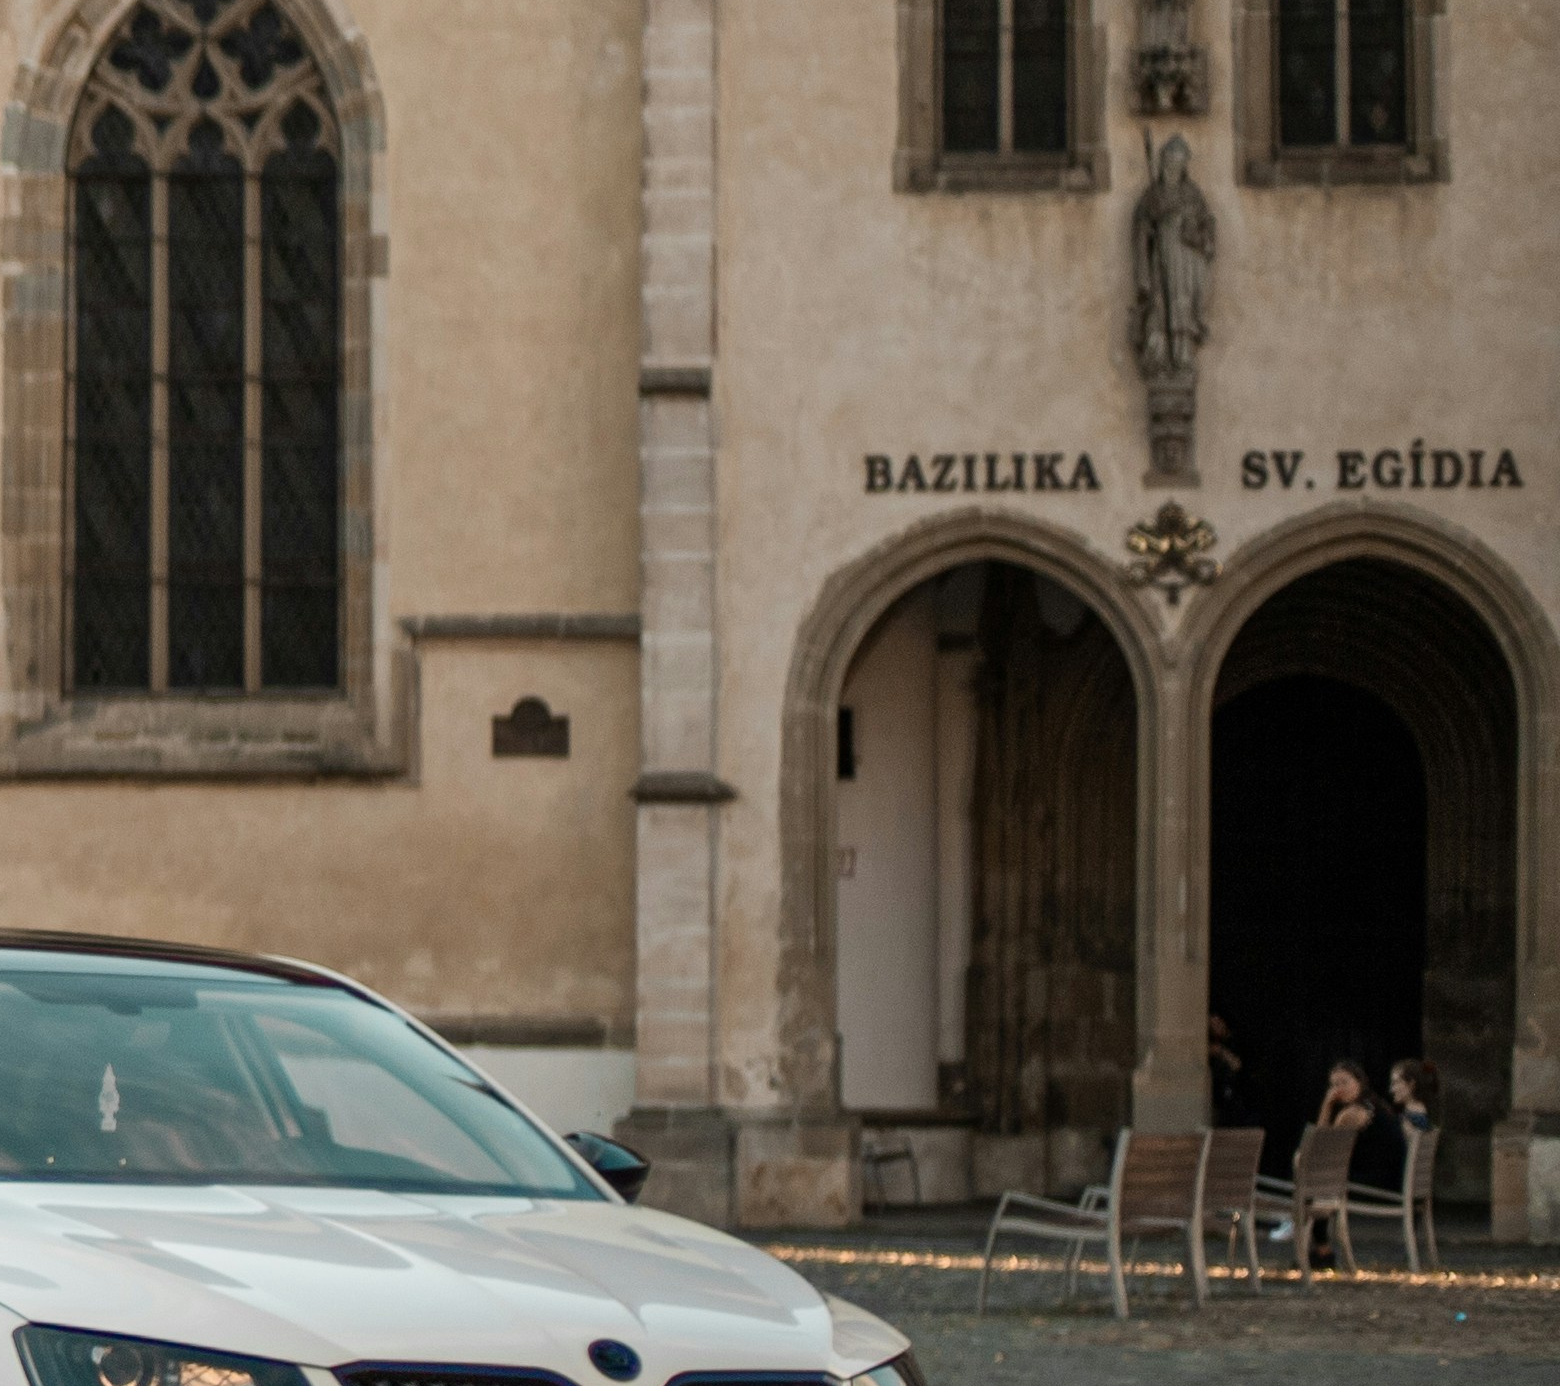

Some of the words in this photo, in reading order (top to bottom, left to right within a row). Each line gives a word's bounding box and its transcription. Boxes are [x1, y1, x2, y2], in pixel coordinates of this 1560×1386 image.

[863, 452, 1101, 493] BAZILIKA
[1242, 450, 1314, 490] SV.
[1337, 438, 1525, 489] EGÍDIA
